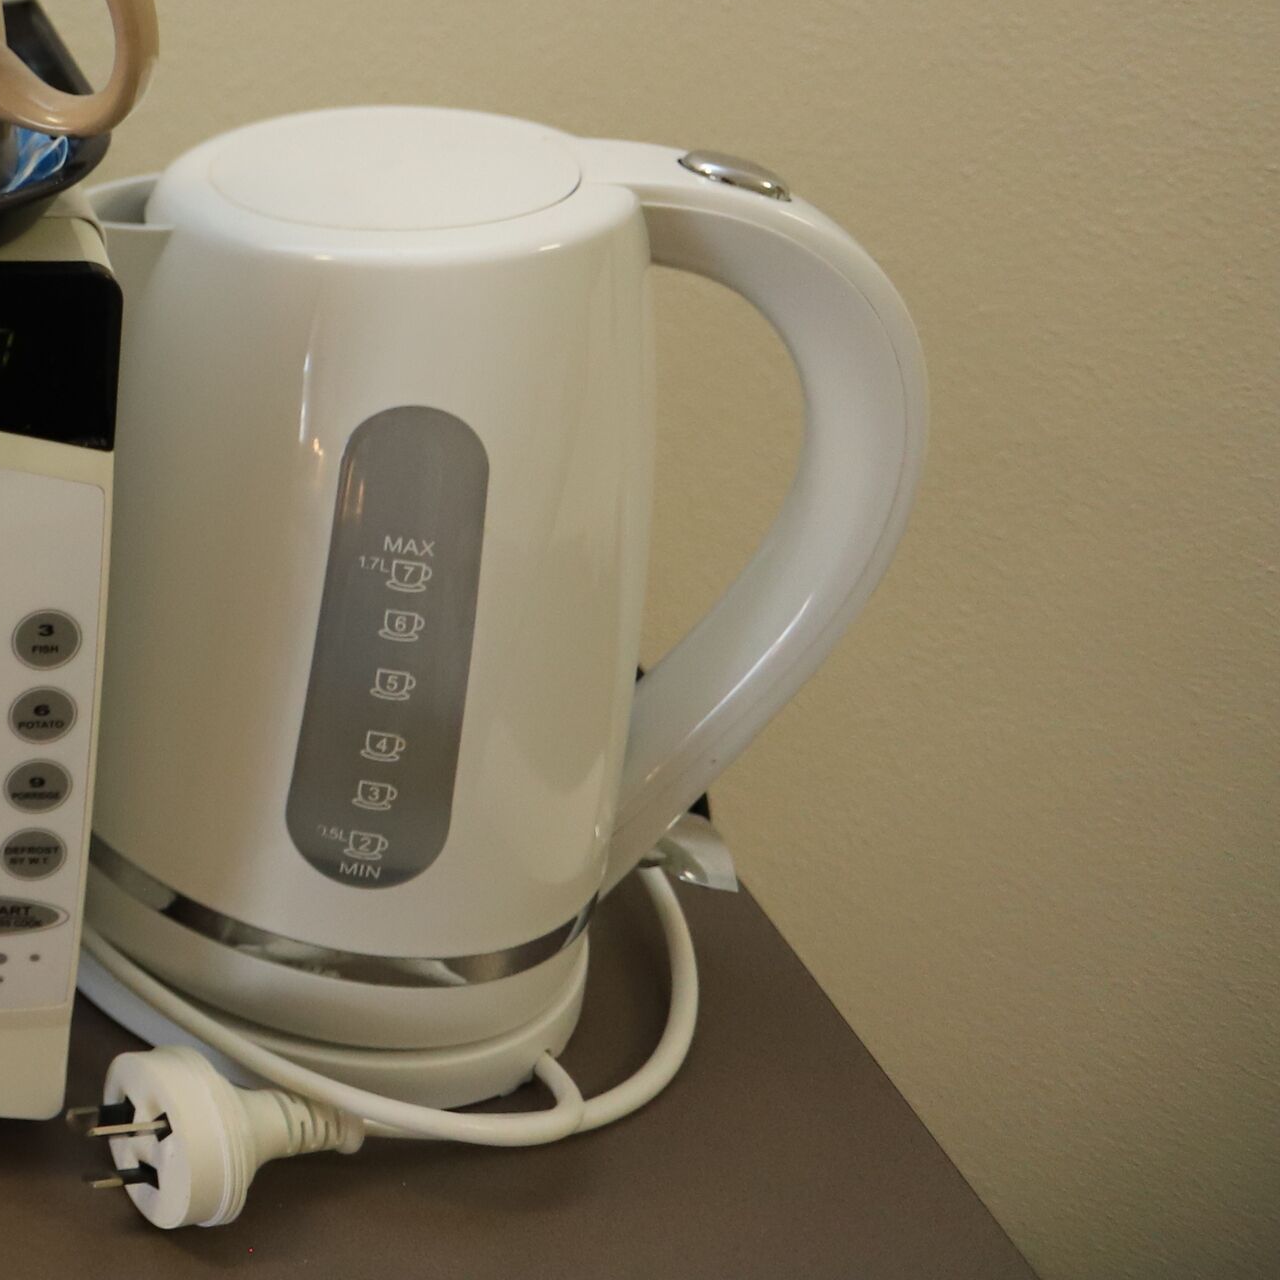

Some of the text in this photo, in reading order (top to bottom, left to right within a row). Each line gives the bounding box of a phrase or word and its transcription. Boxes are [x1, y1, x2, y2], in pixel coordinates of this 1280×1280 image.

[383, 535, 436, 557] MAX
[403, 565, 415, 582] 7
[37, 624, 54, 637] 3
[395, 615, 407, 632] 6
[32, 645, 59, 654] FISH
[386, 674, 398, 691] 5
[33, 705, 50, 717] 6
[17, 720, 65, 730] POTATO
[376, 737, 387, 752] 4
[28, 777, 46, 789] 9
[368, 786, 380, 801] 3
[5, 846, 59, 855] DEFROST
[358, 837, 372, 851] 2
[339, 861, 381, 880] MIN
